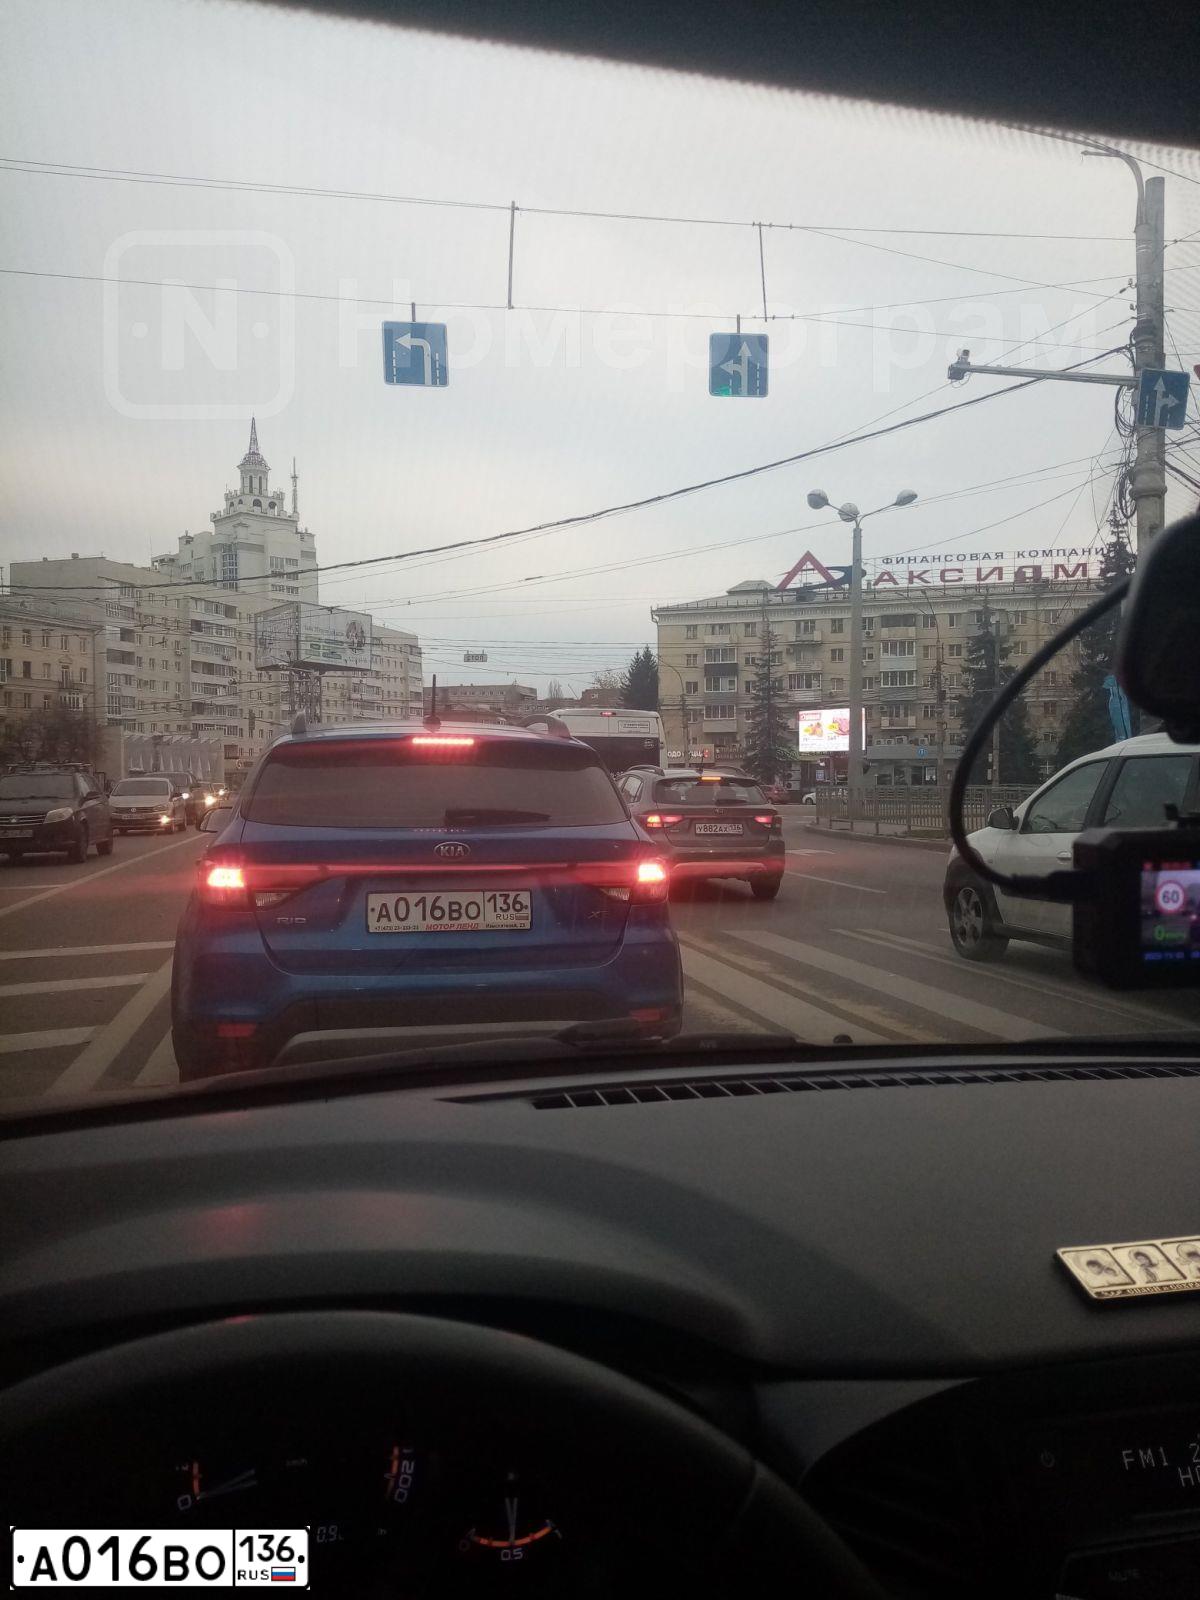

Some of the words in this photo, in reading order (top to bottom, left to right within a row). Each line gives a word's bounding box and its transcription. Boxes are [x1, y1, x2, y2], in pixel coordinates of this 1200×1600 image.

[882, 552, 1004, 565] ФИНАНСОВАЯ
[1017, 547, 1104, 559] КОМПАНИ
[872, 562, 1106, 586] АКСИОМ
[1162, 890, 1180, 904] 60
[376, 895, 481, 923] А016ВО
[487, 893, 523, 913] 136
[496, 913, 514, 921] RUS
[1122, 1446, 1169, 1471] FM1
